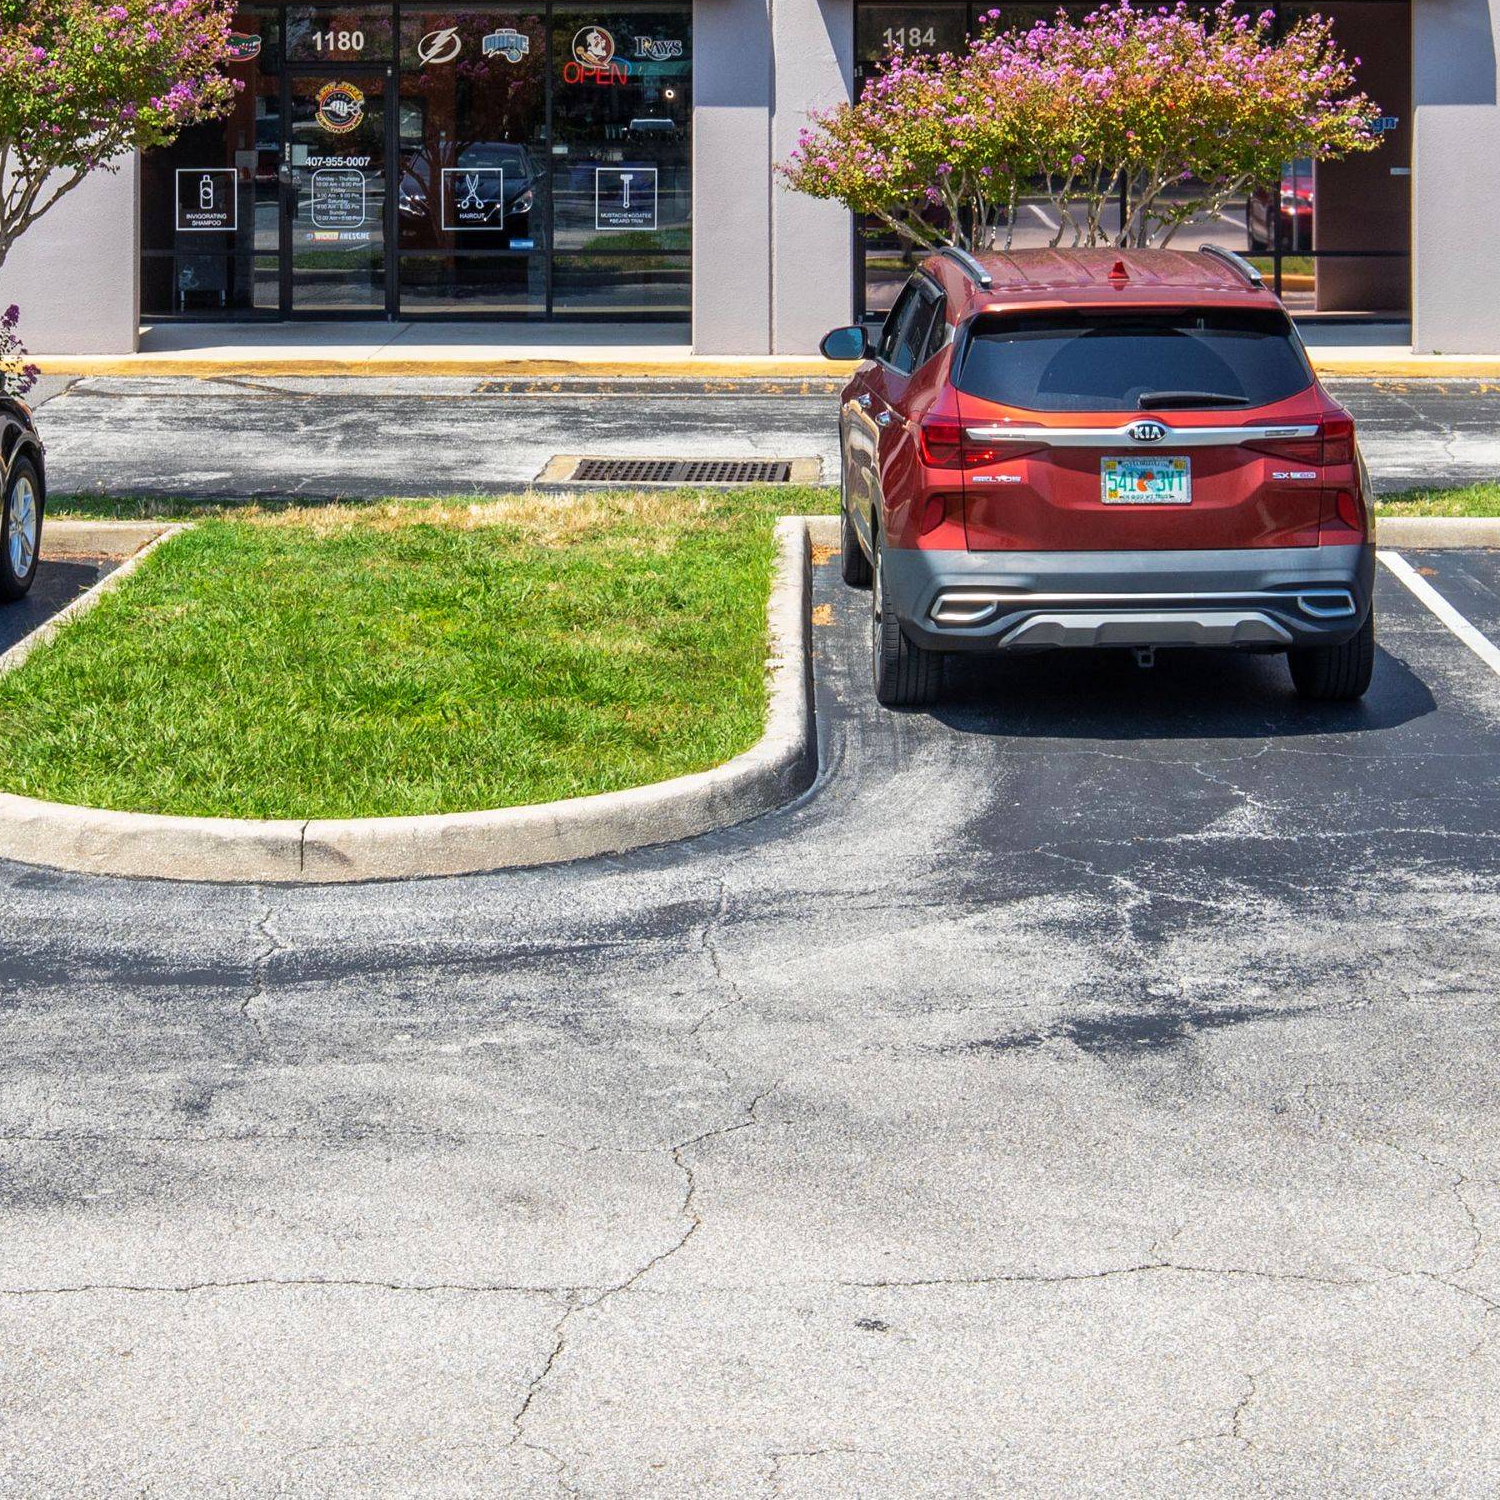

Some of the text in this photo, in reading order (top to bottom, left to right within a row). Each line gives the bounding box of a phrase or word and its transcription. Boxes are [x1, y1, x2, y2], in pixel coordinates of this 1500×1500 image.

[312, 31, 364, 51] 1180
[883, 27, 936, 47] 1184
[634, 36, 683, 61] RAYS
[563, 61, 627, 85] OPEN
[305, 156, 371, 167] 407-955-0007
[1134, 426, 1162, 439] KIA
[1156, 470, 1184, 492] 3VT
